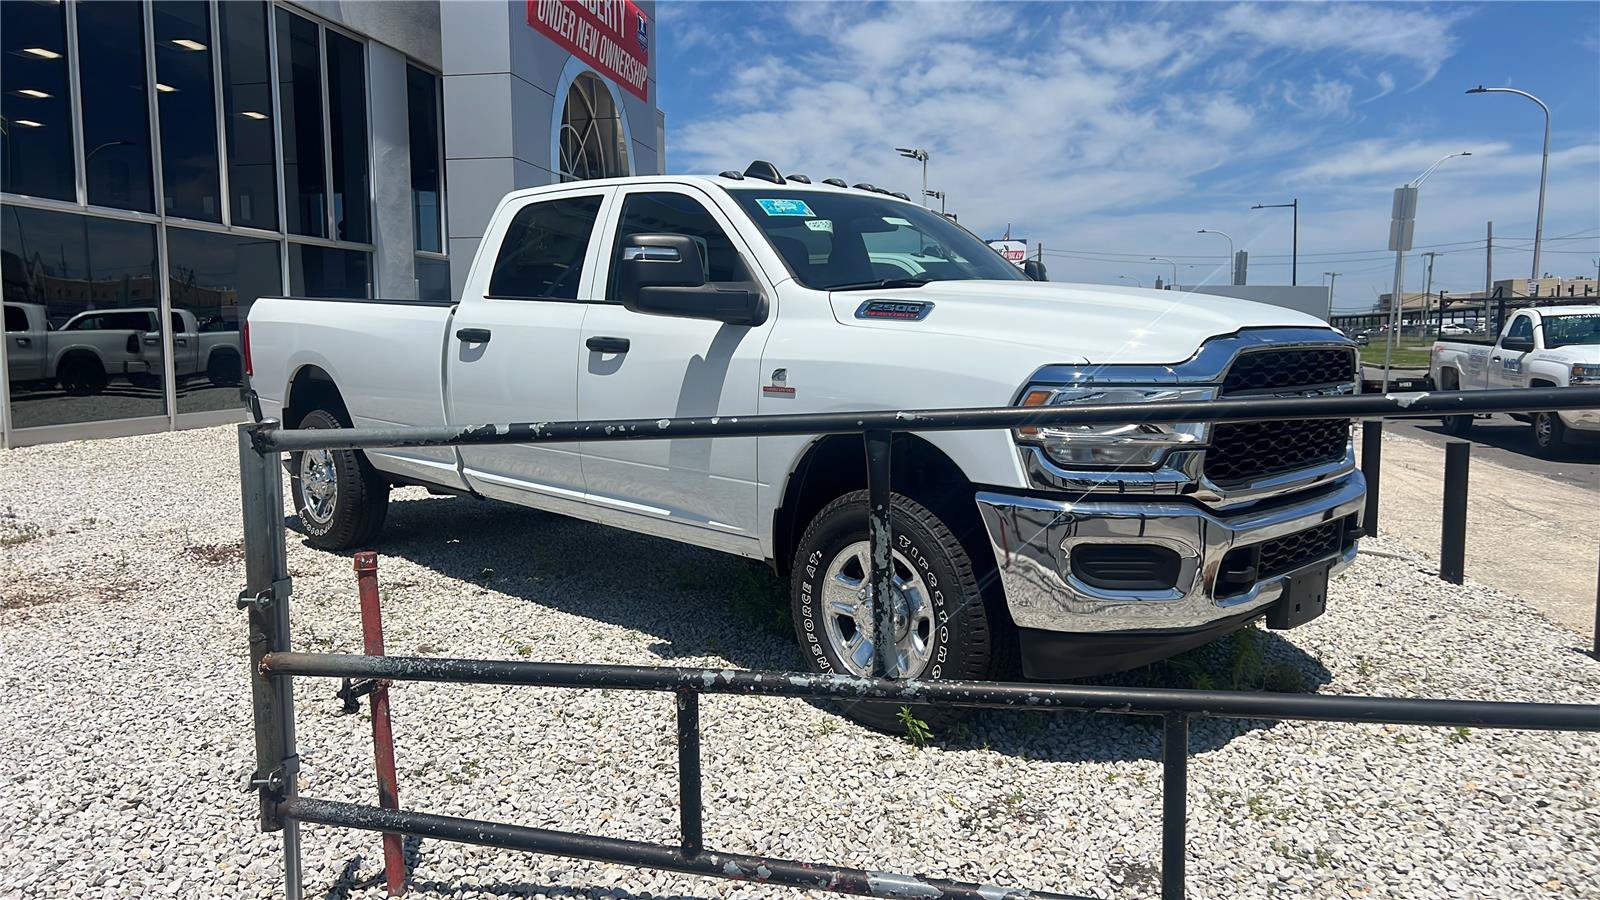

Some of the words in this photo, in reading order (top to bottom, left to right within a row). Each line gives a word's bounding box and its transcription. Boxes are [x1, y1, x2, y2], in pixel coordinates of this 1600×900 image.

[577, 0, 625, 38] ERTY
[537, 0, 577, 42] UNDER
[575, 17, 600, 58] NEW
[599, 35, 648, 90] OWNERSHIP
[869, 303, 920, 313] 2500
